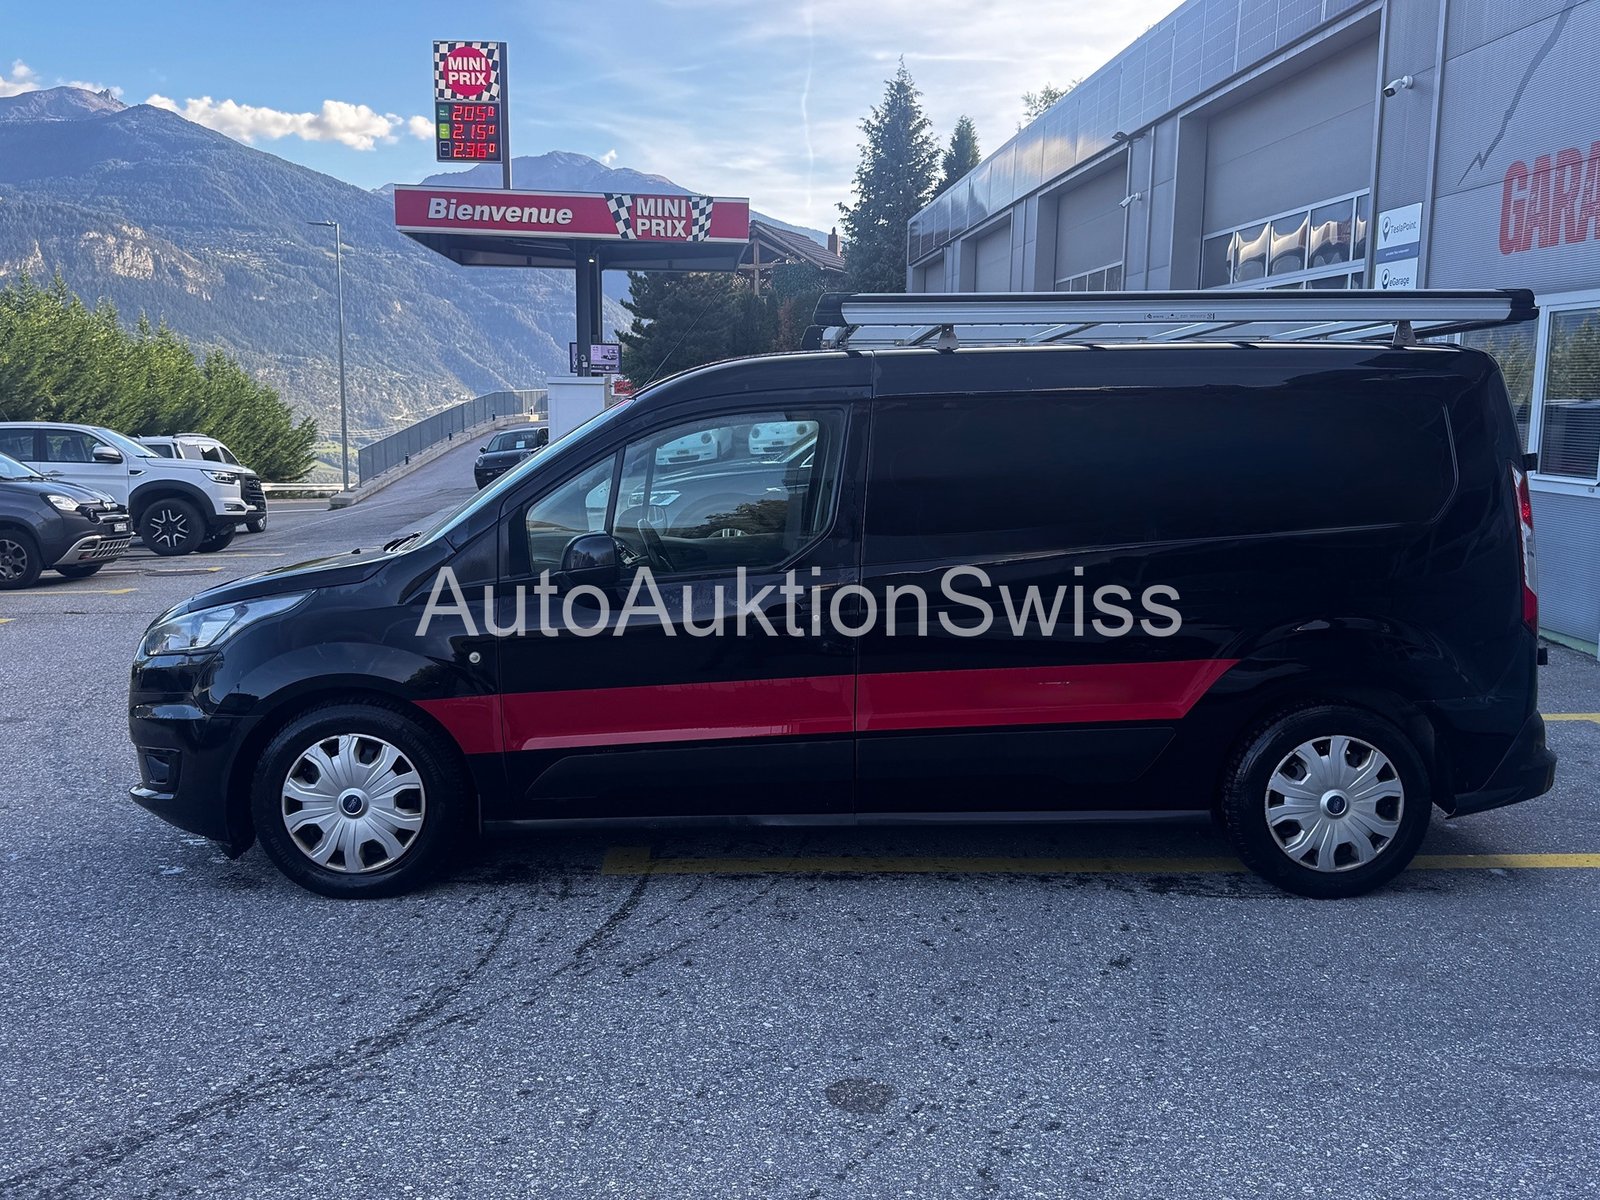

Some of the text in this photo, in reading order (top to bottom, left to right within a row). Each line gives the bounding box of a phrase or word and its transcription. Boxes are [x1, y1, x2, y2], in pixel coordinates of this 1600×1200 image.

[448, 57, 486, 71] MINI
[448, 72, 487, 86] PRIX
[427, 197, 573, 225] Bienvenue
[636, 197, 687, 218] MINI
[636, 218, 687, 238] PRIX
